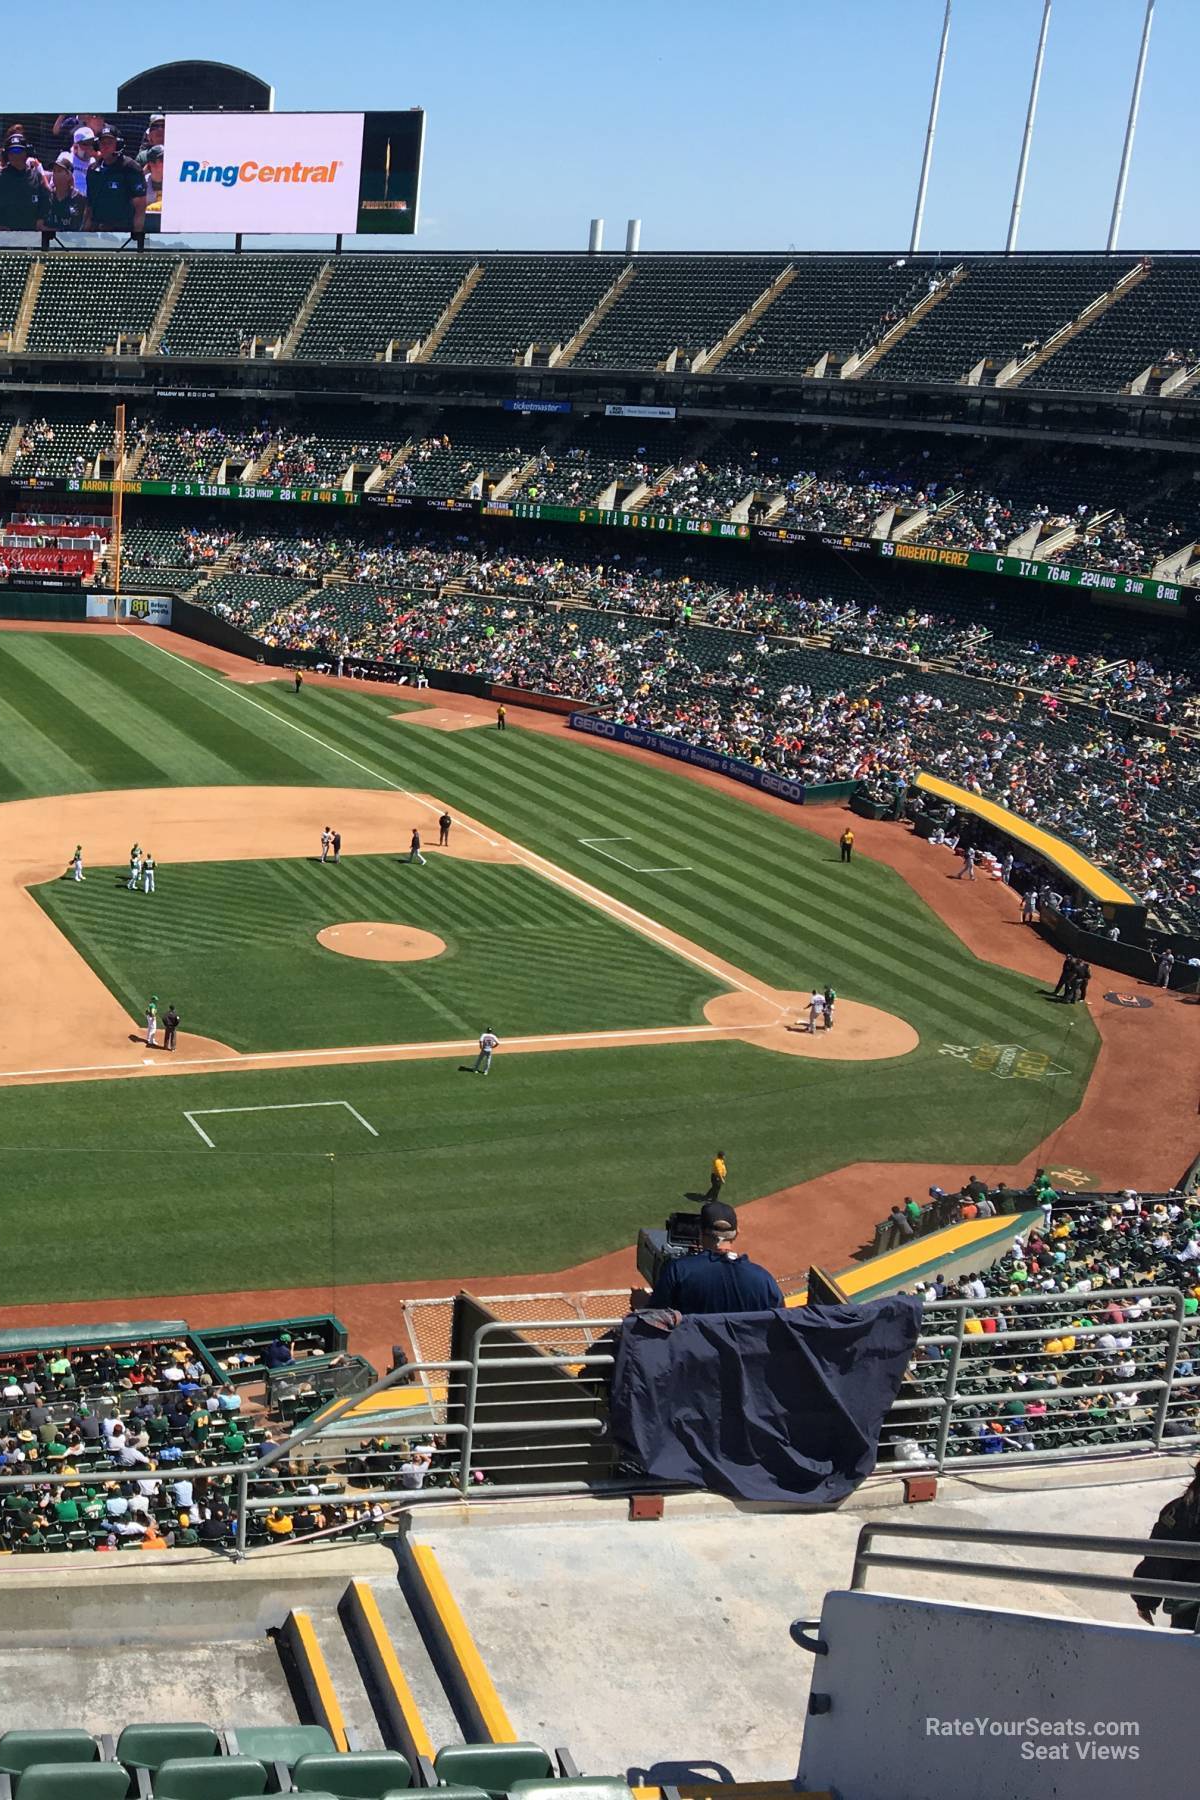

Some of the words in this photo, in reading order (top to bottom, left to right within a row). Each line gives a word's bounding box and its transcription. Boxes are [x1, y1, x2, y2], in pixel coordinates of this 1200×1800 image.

[179, 160, 338, 187] RingCentral
[513, 401, 559, 411] ticketmaster
[68, 479, 79, 490] 35
[81, 480, 109, 491] AARON
[112, 481, 142, 492] BROOKS
[200, 485, 217, 496] 5.19
[218, 488, 231, 496] ERA
[238, 486, 255, 498] 1.33
[256, 489, 274, 498] WHIP
[280, 489, 290, 500] 28
[291, 491, 297, 500] K
[301, 490, 311, 501] 27
[624, 516, 629, 525] B
[641, 517, 647, 527] S
[686, 521, 699, 531] CLE
[720, 524, 736, 535] OAK
[786, 533, 806, 541] CREEK
[822, 537, 841, 545] CACHE
[851, 541, 871, 549] CREEK
[881, 542, 894, 555] 55
[895, 544, 938, 562] ROBERTO
[938, 551, 969, 567] PEREZ
[996, 559, 1003, 572] C
[1019, 562, 1031, 576] 17
[1031, 567, 1037, 576] H
[1047, 566, 1059, 580] 76
[1059, 571, 1070, 582] AB
[1077, 571, 1100, 588] .224
[1100, 578, 1116, 589] AVG
[1125, 579, 1132, 593] 3
[1132, 583, 1144, 594] HR
[1157, 585, 1164, 599] 8
[1164, 588, 1178, 600] RBI
[132, 600, 148, 611] 811
[574, 715, 615, 737] GEICO
[624, 730, 643, 745] Over
[646, 736, 656, 748] 75
[660, 739, 679, 756] Years
[681, 745, 690, 756] of
[690, 748, 720, 769] Savings
[760, 774, 801, 800] GEICO
[938, 1043, 972, 1059] 24
